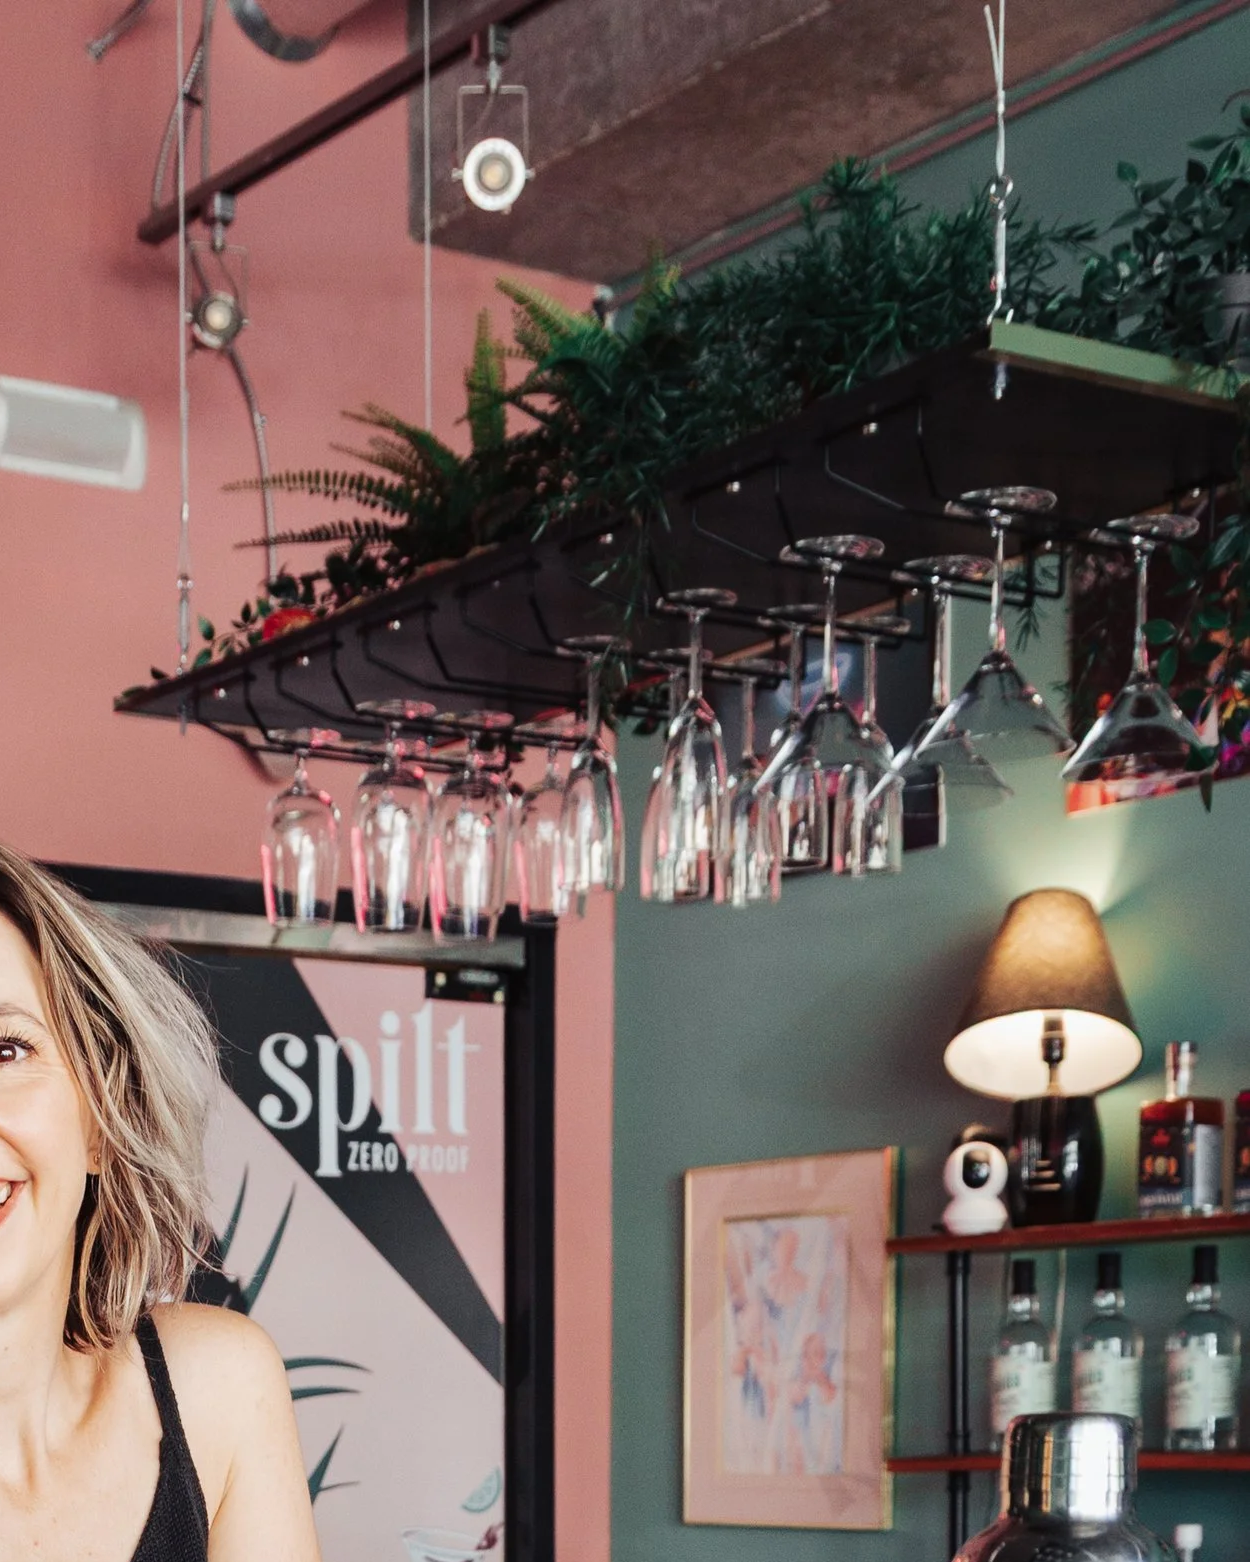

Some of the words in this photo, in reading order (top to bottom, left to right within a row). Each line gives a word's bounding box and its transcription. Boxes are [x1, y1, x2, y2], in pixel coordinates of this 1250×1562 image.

[258, 999, 481, 1178] spilt
[347, 1141, 399, 1172] ZERO
[405, 1144, 469, 1174] PROOF
